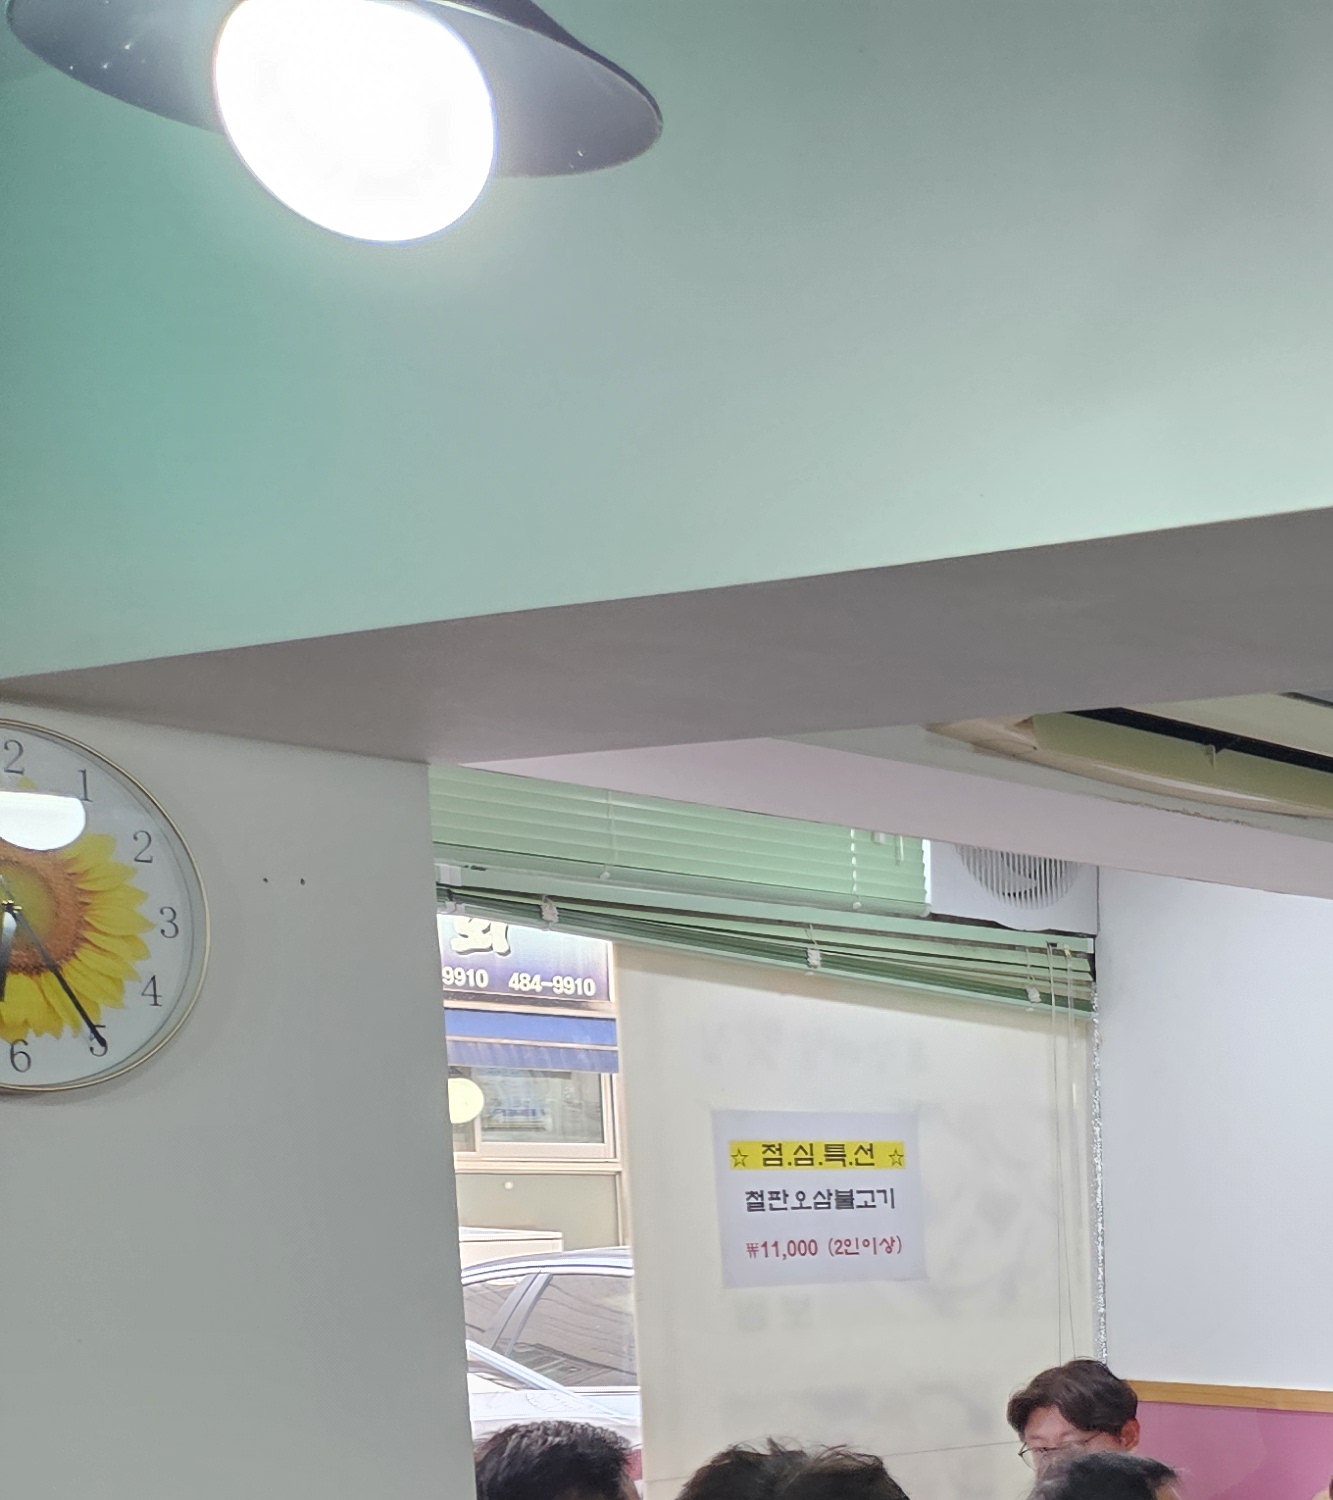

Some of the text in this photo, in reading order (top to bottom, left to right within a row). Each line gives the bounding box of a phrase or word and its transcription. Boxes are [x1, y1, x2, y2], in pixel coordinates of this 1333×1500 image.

[78, 769, 94, 802] 1
[133, 830, 154, 863] 2
[160, 906, 180, 939] 3
[141, 975, 162, 1006] 4
[508, 972, 596, 997] 484-9910
[9, 1039, 31, 1073] 6
[828, 1235, 902, 1257] (2인이상)
